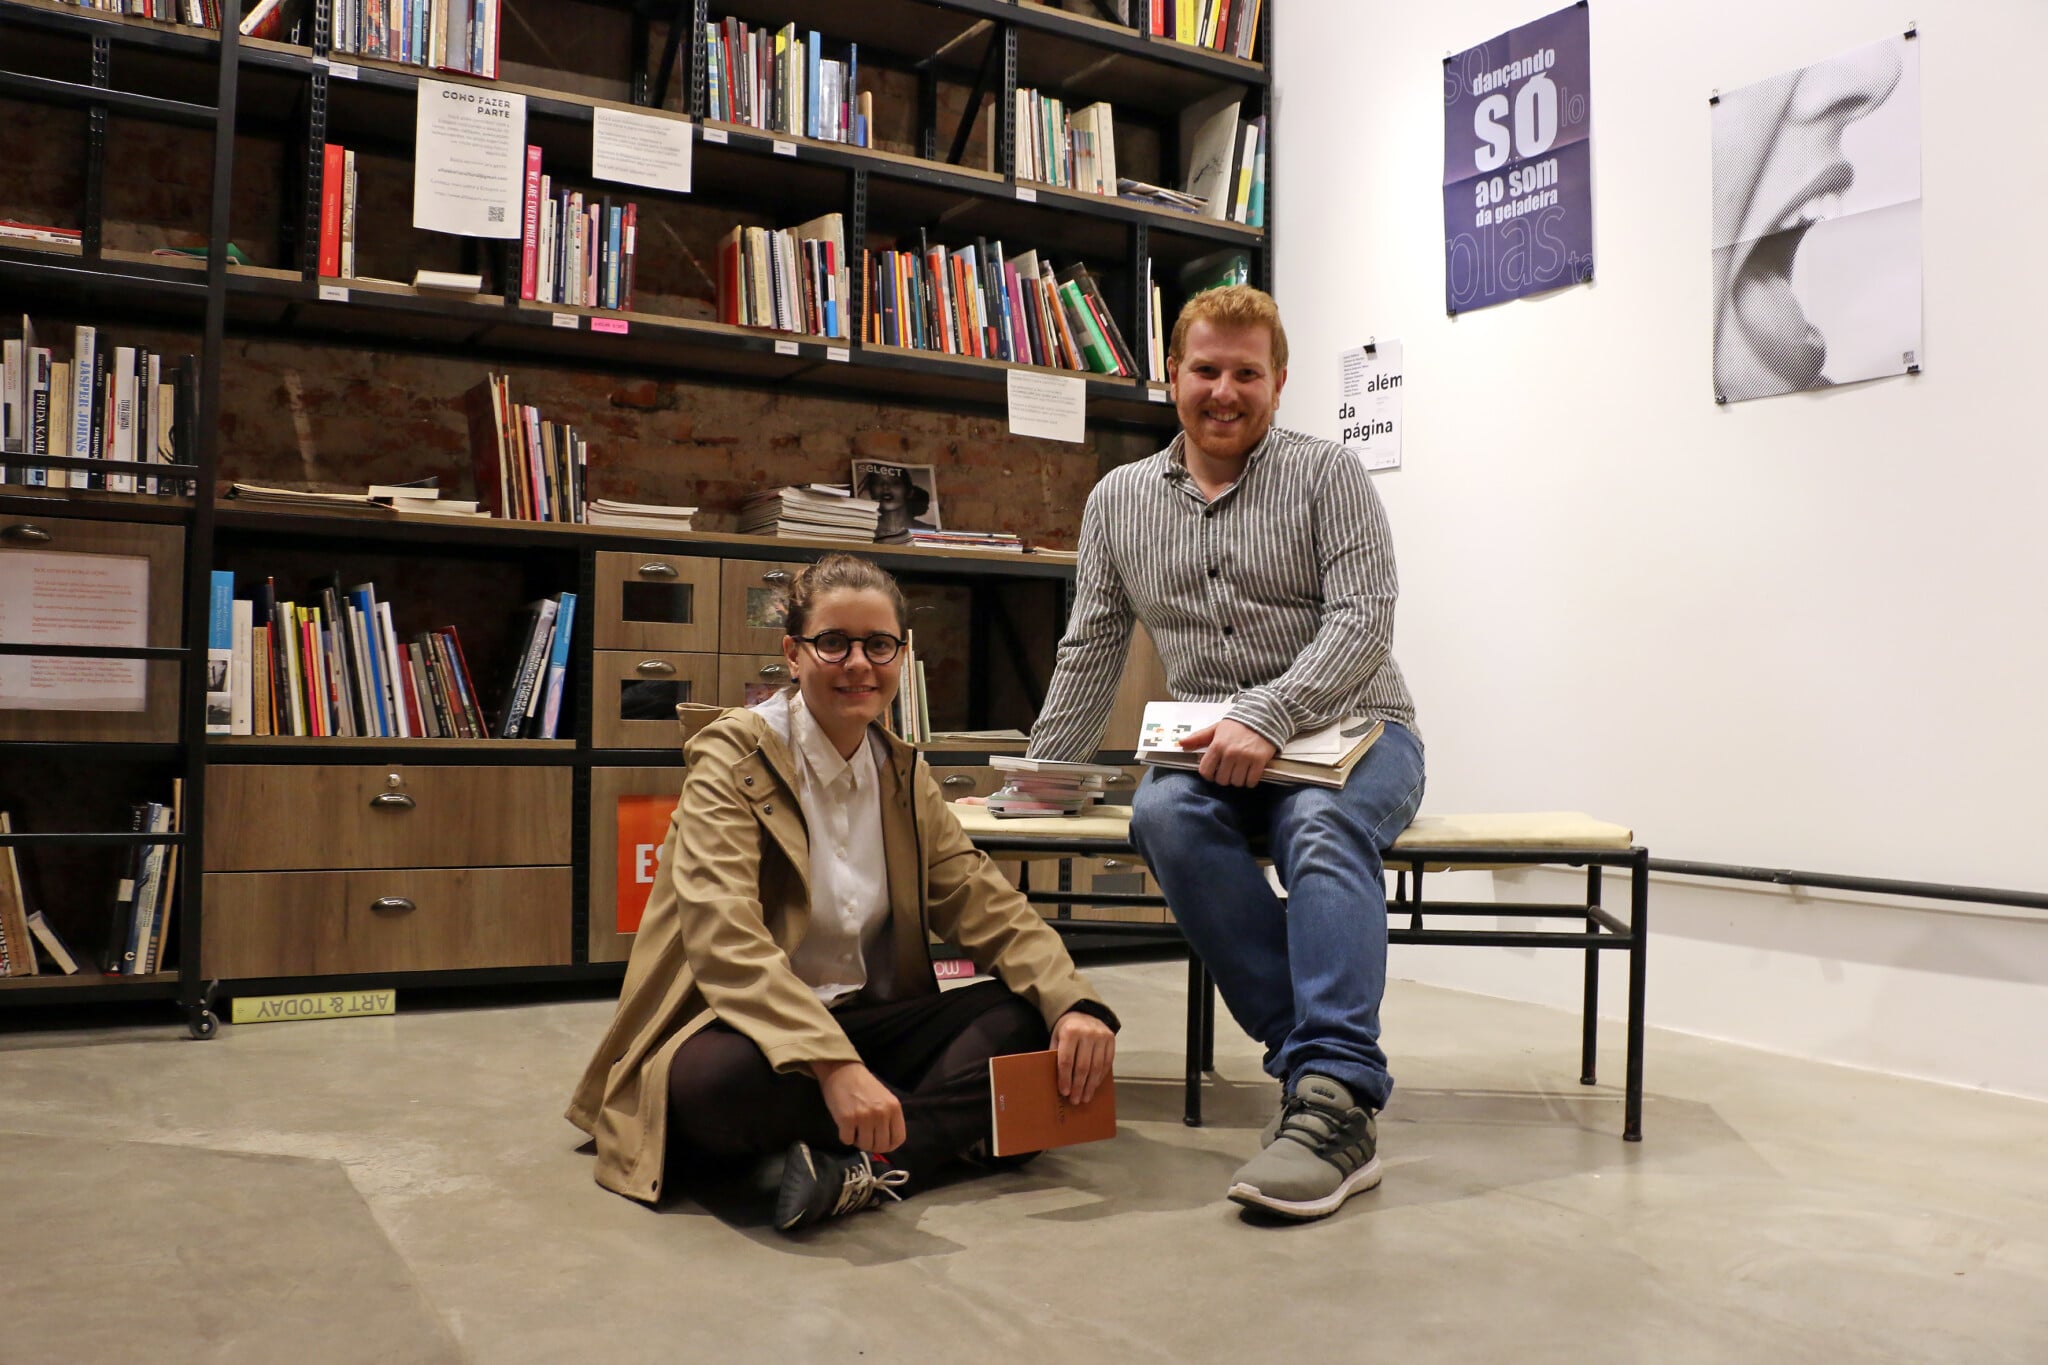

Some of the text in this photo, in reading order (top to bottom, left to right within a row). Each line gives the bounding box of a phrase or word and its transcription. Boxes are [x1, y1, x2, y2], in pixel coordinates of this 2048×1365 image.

[1472, 48, 1556, 97] dançando
[442, 90, 511, 109] COMO FAZER
[477, 106, 511, 119] PARTE
[1473, 71, 1558, 172] SÓ
[526, 183, 537, 198] ARE
[527, 170, 537, 181] WE
[1475, 157, 1559, 209] ao som
[1475, 187, 1559, 229] da geladeira
[525, 200, 537, 249] EVERYWHERE
[79, 360, 91, 408] JASPER
[1367, 373, 1403, 393] além
[35, 393, 47, 423] FRIDA
[1338, 402, 1356, 420] da
[34, 425, 46, 455] KAHL
[75, 410, 90, 452] JOHNS
[1343, 418, 1393, 445] página
[256, 993, 390, 1018] ART & TODAY
